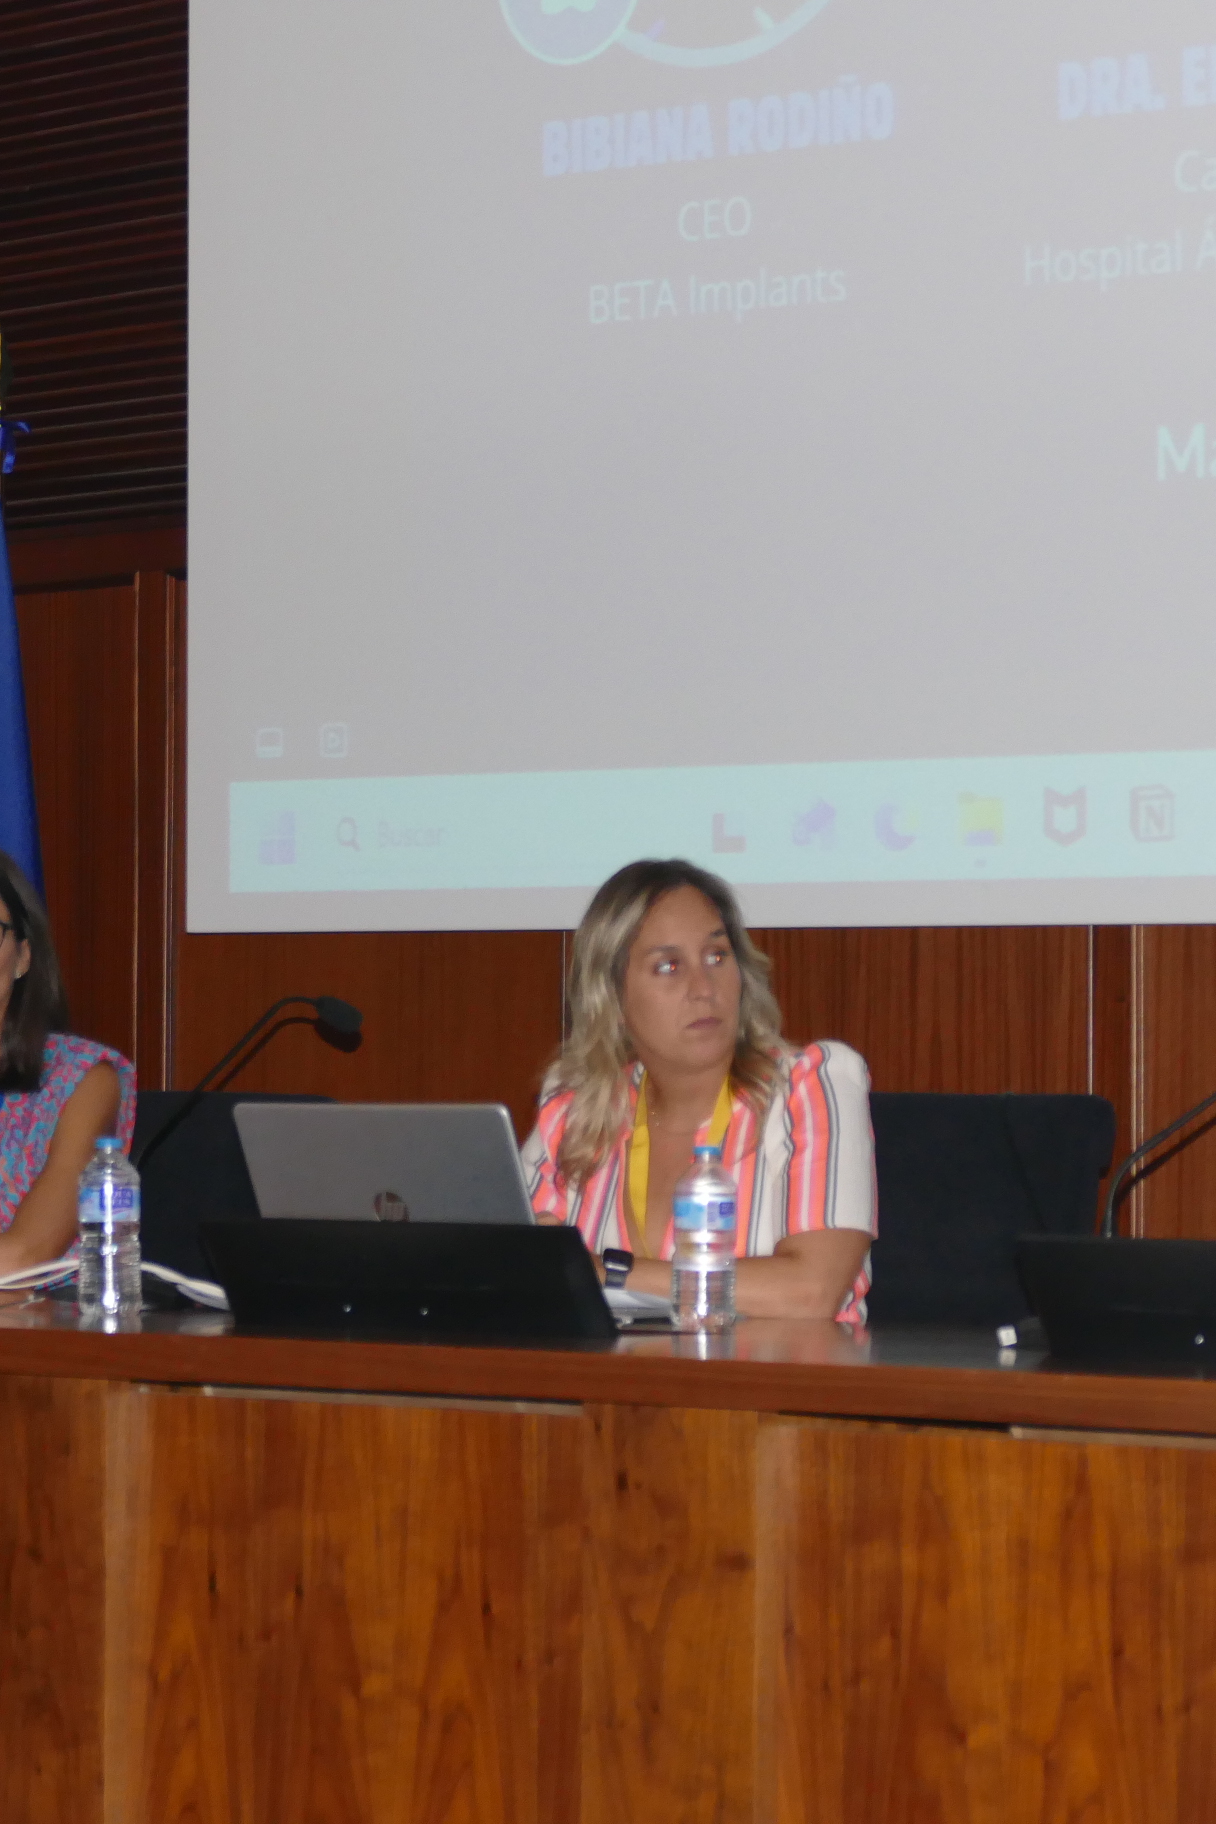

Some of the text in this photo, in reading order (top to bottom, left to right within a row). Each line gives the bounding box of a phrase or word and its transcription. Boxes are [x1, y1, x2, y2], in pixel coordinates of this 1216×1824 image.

[1058, 45, 1216, 120] DRA. E
[542, 73, 895, 177] BIBIANA RODIÑO
[677, 196, 753, 242] CEO
[1023, 228, 1183, 292] Hospital
[588, 266, 847, 325] BETA Implants
[1157, 423, 1216, 481] M
